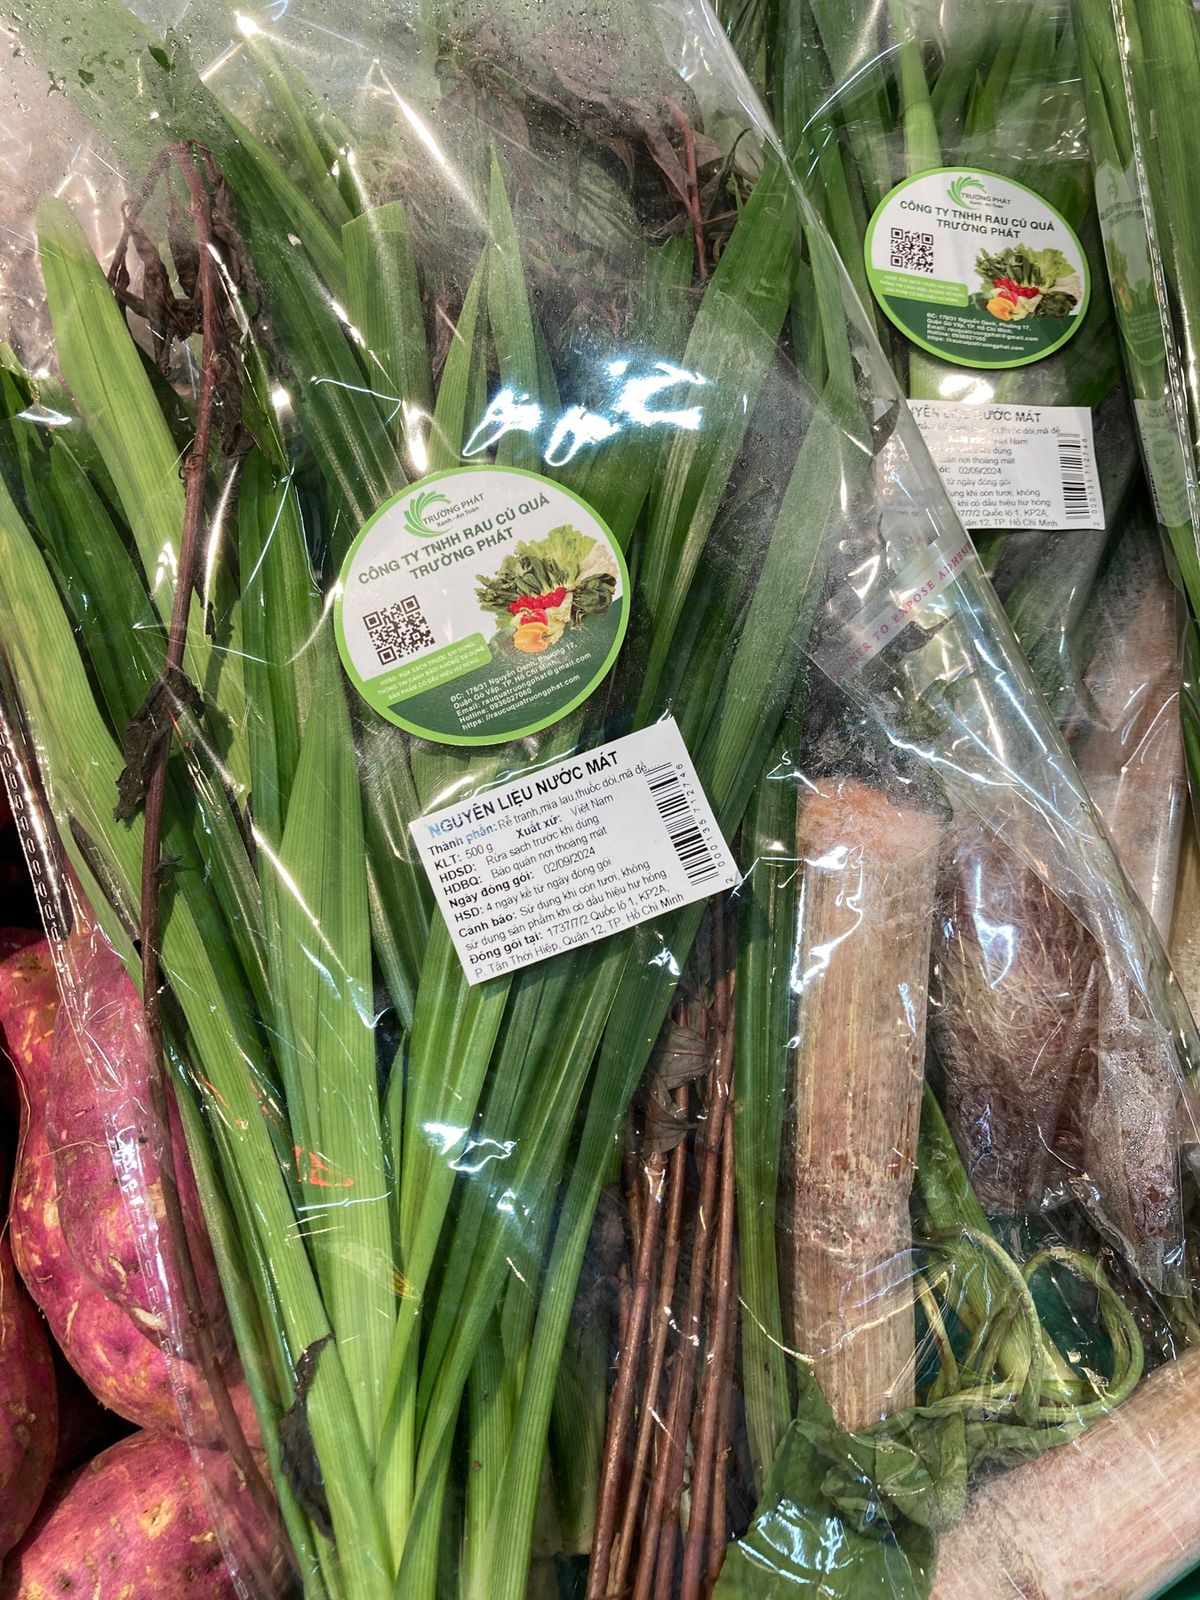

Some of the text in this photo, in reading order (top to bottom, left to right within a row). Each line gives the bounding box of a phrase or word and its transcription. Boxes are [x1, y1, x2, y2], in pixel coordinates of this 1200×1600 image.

[900, 200, 932, 213] CÔNG
[935, 207, 949, 216] TY
[951, 210, 982, 221] TNHH
[985, 215, 1008, 225] RAU
[1011, 217, 1026, 228] CỦ
[1030, 220, 1055, 231] QUẢ
[936, 218, 1020, 238] TRƯỜNG PHÁT
[1015, 409, 1041, 422] MÁT
[958, 466, 1001, 475] 02/09/2024
[460, 492, 484, 509] PHÁT
[357, 492, 550, 585] CÔNG TY TNHH RAU CỦ QUẢ
[409, 526, 514, 580] TRƯỜNG PHÁT
[871, 579, 938, 641] TO EXPOSE
[450, 692, 464, 703] ĐC:
[465, 681, 488, 696] 178/31
[488, 669, 516, 686] Nguyễn
[453, 697, 473, 710] Quận
[456, 702, 481, 717] Email:
[458, 707, 488, 723] Hotline:
[461, 717, 484, 731] https:
[429, 749, 618, 835] NGUYÊN LIỆU NƯỚC MÁT
[675, 763, 700, 813] 712746
[427, 836, 464, 856] Thành
[465, 822, 498, 844] phần:
[497, 814, 513, 829] Rễ
[434, 794, 614, 870] KLT: 500 g Xuất xứ: Việt Nam
[439, 863, 476, 883] HDSD:
[485, 851, 508, 866] Rửa
[508, 841, 532, 857] sạch
[559, 825, 574, 836] khi
[575, 814, 600, 830] dùng
[698, 818, 725, 868] 000135
[443, 826, 607, 896] HDBQ: Bảo quản nơi thoáng mát
[448, 846, 596, 909] Ngày đóng gói: 02/09/2024
[454, 857, 612, 923] HSD: 4 ngày kể từ ngày đóng gói
[458, 921, 489, 938] Cảnh
[490, 911, 517, 927] báo:
[519, 903, 534, 916] Sử
[536, 895, 562, 911] dụng
[562, 889, 577, 900] khi
[596, 873, 620, 887] tươi,
[620, 860, 651, 878] không
[465, 939, 478, 951] sử
[480, 930, 507, 946] dụng
[507, 924, 526, 936] sản
[527, 911, 556, 930] phẩm
[555, 907, 571, 918] khi
[585, 892, 604, 907] dấu
[604, 885, 627, 900] hiệu
[626, 879, 641, 890] hư
[641, 869, 667, 885] hỏng
[469, 947, 502, 965] Đóng
[503, 939, 523, 955] gói
[524, 931, 543, 946] tại:
[546, 914, 589, 937] 1737/7/2
[589, 903, 616, 921] Quốc
[638, 883, 670, 902] KP2A,
[474, 893, 684, 978] P. Tân Thới Hiệp, Quận 12, TP. Hồ Chí Minh
